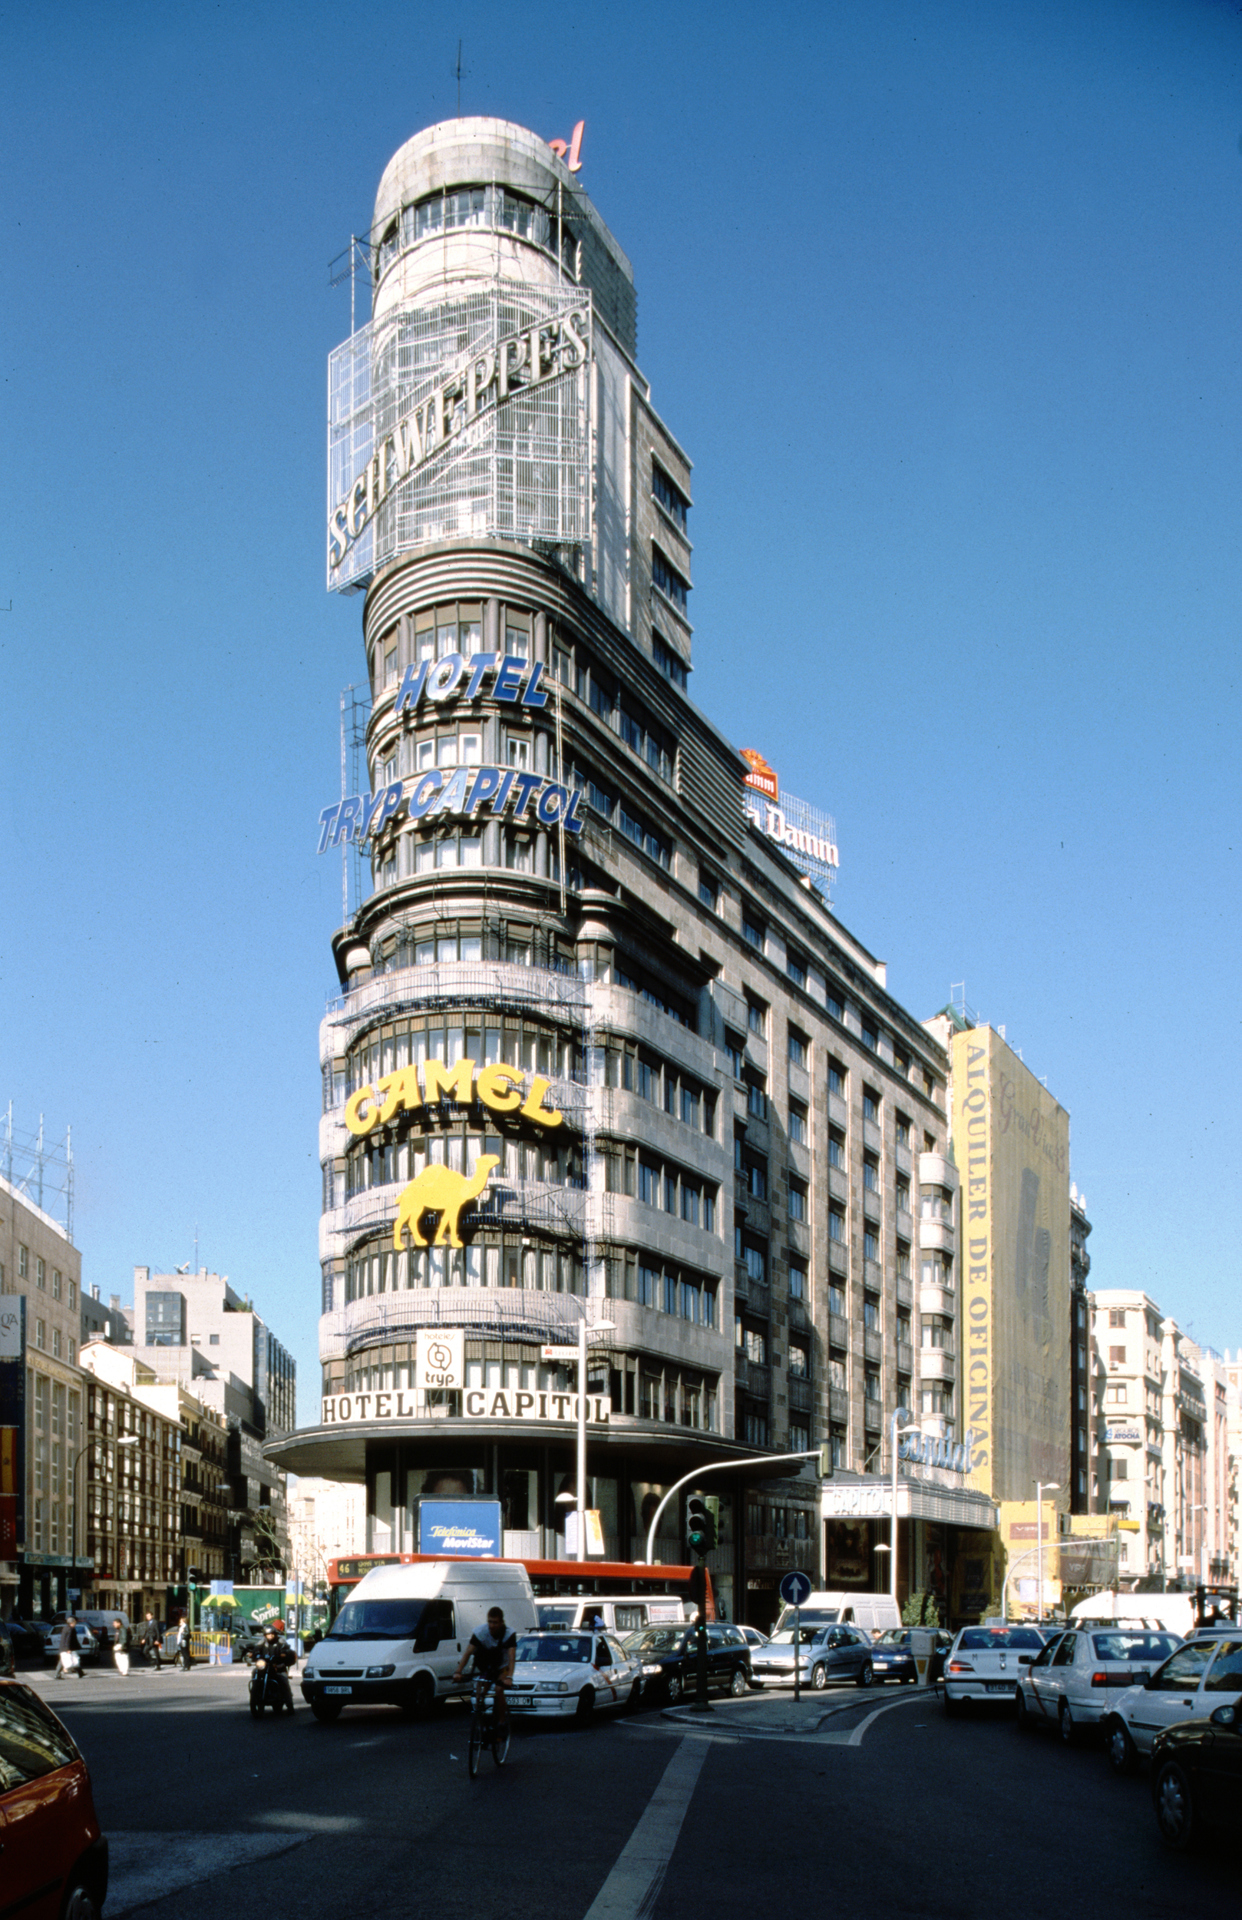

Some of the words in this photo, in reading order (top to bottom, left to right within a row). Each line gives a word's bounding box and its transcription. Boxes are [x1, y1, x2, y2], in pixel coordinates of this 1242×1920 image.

[329, 308, 587, 568] SCHWEPPES
[394, 652, 548, 713] HOTEL
[317, 781, 404, 853] TRYP
[408, 767, 585, 833] CAPITOL
[765, 803, 840, 868] Damm
[345, 1059, 563, 1135] CAMEL
[962, 1044, 987, 1221] ALQUILER
[969, 1234, 987, 1285] DE
[424, 1332, 455, 1340] hoteles
[425, 1371, 455, 1387] tryp
[968, 1296, 989, 1468] OFICINAS
[323, 1393, 414, 1423] HOTEL
[466, 1391, 610, 1424] CAPITOL
[339, 1563, 350, 1574] 46
[442, 1537, 494, 1549] MoviStar
[250, 1603, 280, 1625] Sprite
